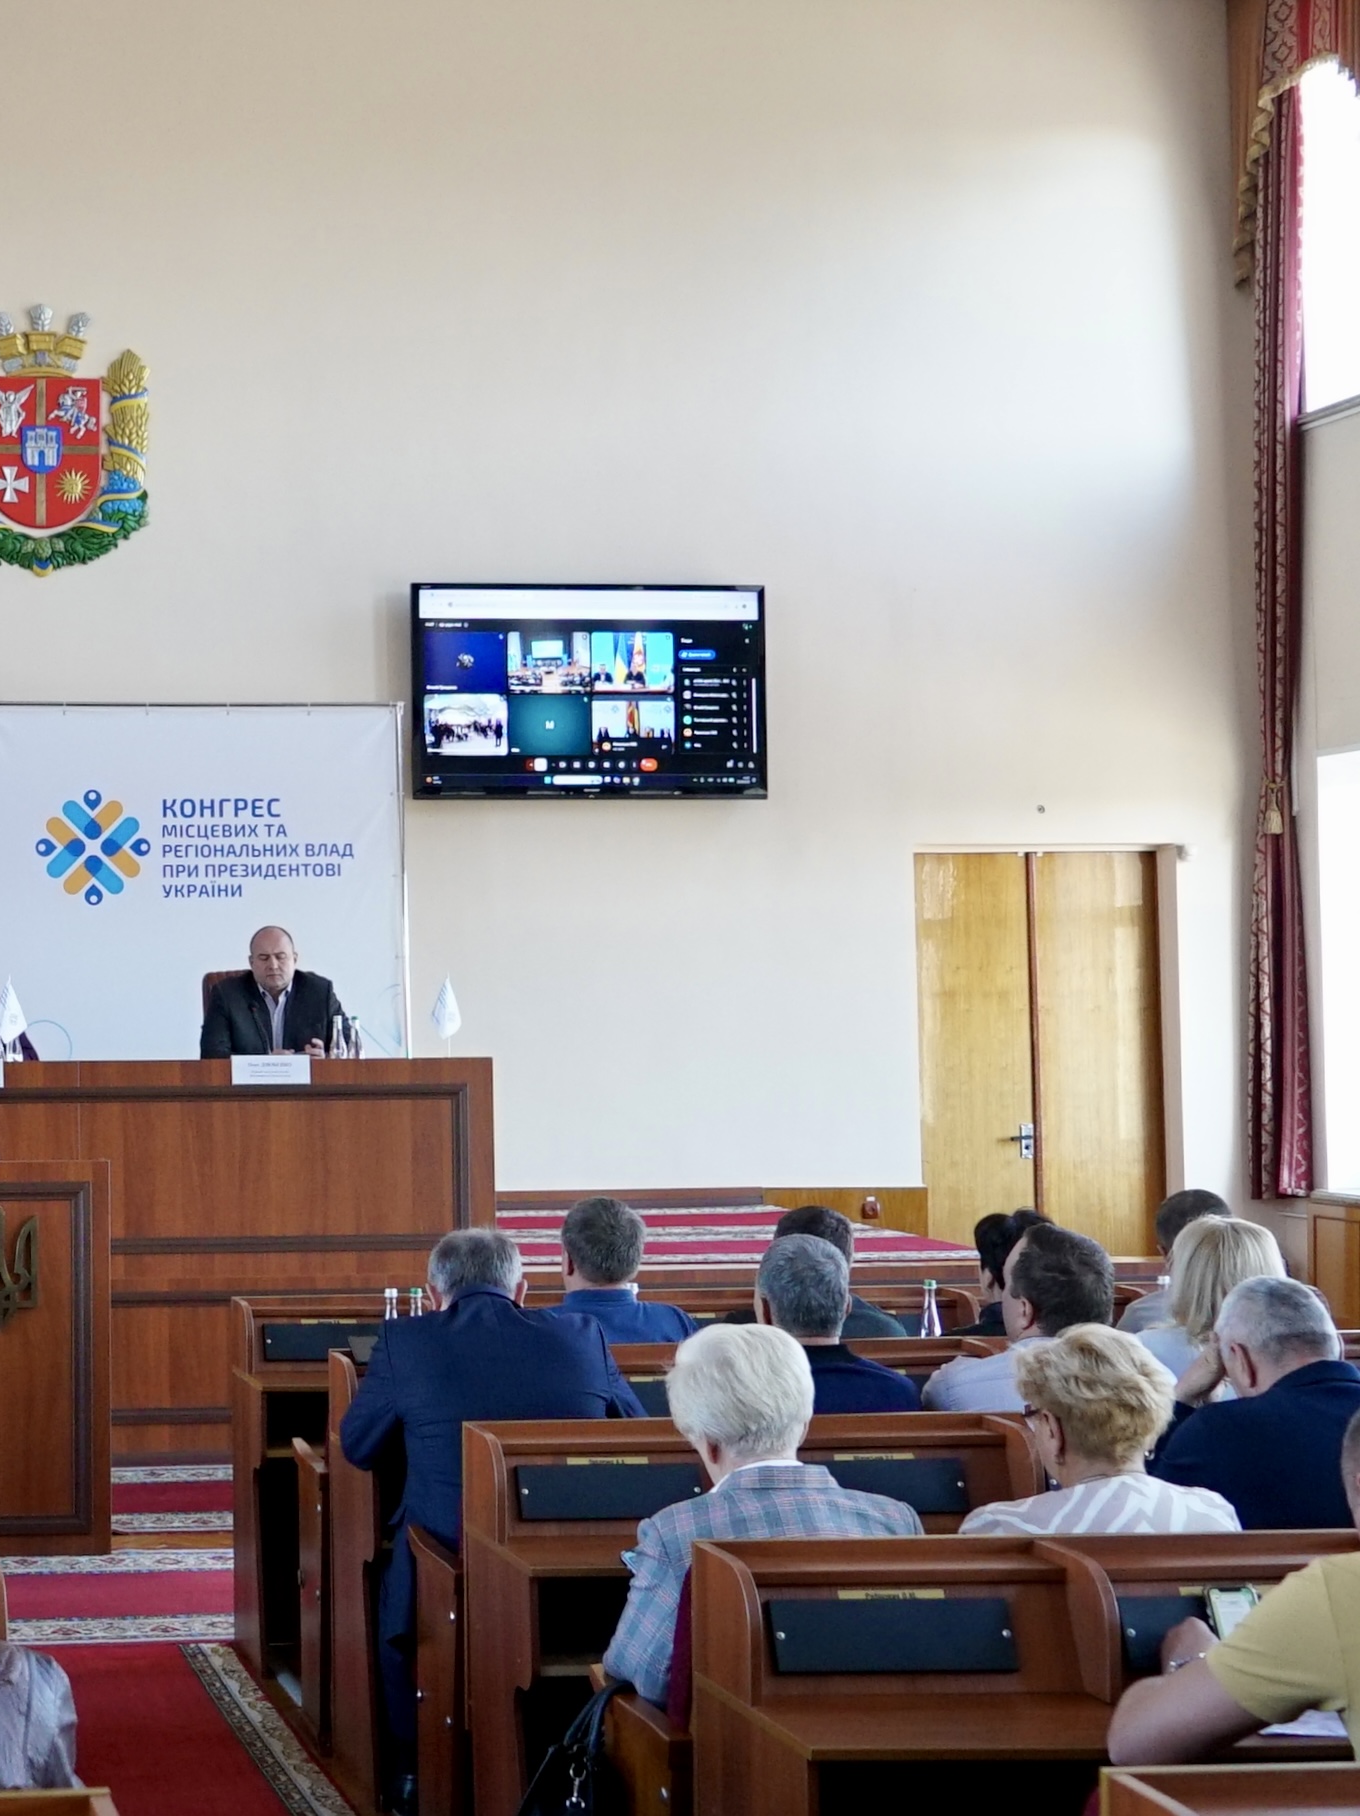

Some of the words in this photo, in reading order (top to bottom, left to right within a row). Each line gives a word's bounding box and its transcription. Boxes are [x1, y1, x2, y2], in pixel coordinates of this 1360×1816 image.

[161, 797, 282, 820] КОНГРЕС
[161, 823, 260, 841] МІСЦЕВИХ
[263, 823, 289, 839] ТА
[161, 843, 300, 859] РЕГІОНАЛЬНИХ
[304, 842, 355, 860] ВЛАД
[162, 863, 200, 879] ПРИ
[204, 862, 342, 881] ПРЕЗИДЕНТОВІ
[161, 879, 243, 899] УКРАЇНИ
